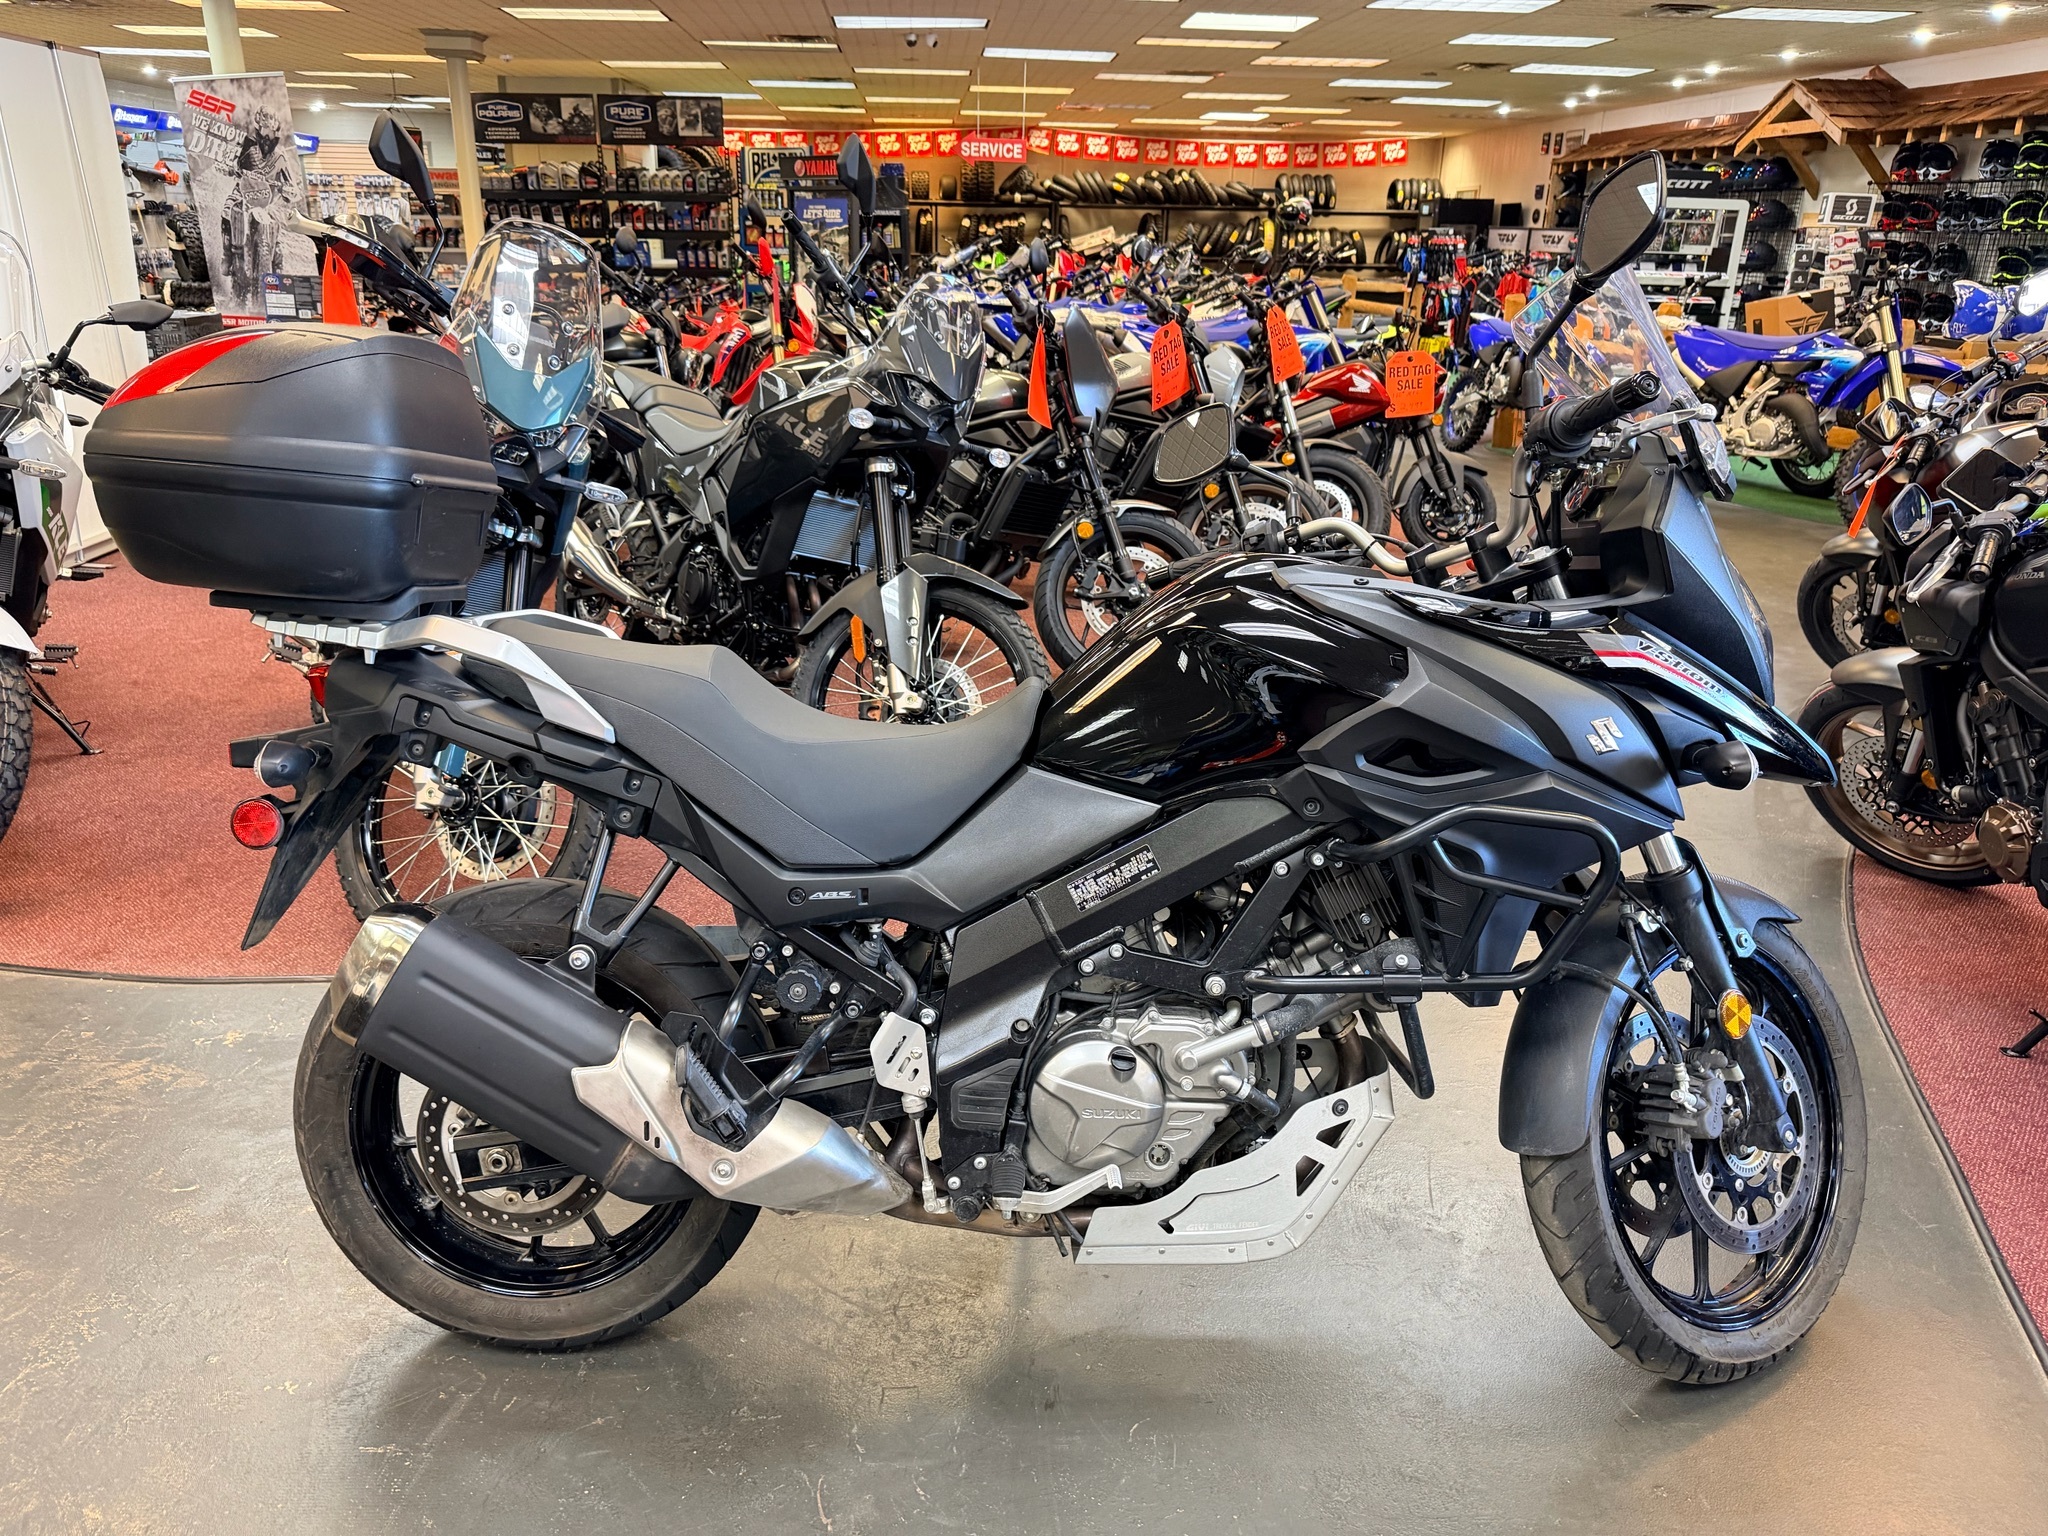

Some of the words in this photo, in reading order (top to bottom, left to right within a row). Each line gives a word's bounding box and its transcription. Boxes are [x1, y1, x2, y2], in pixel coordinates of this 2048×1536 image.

[187, 89, 236, 123] SSR
[610, 106, 645, 116] PURE
[191, 113, 211, 128] WE
[211, 118, 247, 143] KNOW
[1029, 129, 1048, 139] RIDE
[751, 133, 772, 143] RIDE
[784, 134, 804, 143] RIDE
[815, 135, 836, 143] RIDE
[877, 134, 897, 143] RIDE
[907, 133, 927, 143] RIDE
[938, 132, 957, 143] RIDE
[1057, 134, 1077, 144] RIDE
[1087, 136, 1106, 146] RIDE
[818, 142, 839, 154] RED
[879, 141, 900, 154] RED
[909, 141, 931, 153] RED
[940, 140, 958, 153] RE
[961, 141, 1023, 158] SERVICE
[1058, 141, 1079, 153] RED
[1087, 144, 1109, 156] RED
[1116, 139, 1136, 149] RIDE
[1146, 141, 1166, 151] RIDE
[1176, 143, 1196, 152] RIDE
[1206, 144, 1225, 154] RIDE
[1235, 144, 1255, 154] RIDE
[1265, 144, 1285, 155] RIDE
[1295, 145, 1315, 155] RIDE
[1325, 144, 1344, 154] RIDE
[1354, 143, 1373, 153] RIDE
[1384, 141, 1403, 152] RIDE
[1117, 147, 1138, 159] RED
[1147, 149, 1168, 161] RED
[1177, 151, 1198, 163] RED
[1207, 152, 1228, 164] RED
[1236, 152, 1257, 165] RED
[1267, 153, 1288, 165] RED
[1297, 153, 1317, 165] RED
[1326, 152, 1347, 164] RED
[1355, 151, 1376, 163] RED
[1385, 149, 1406, 162] RED
[804, 160, 838, 176] YAMAH
[1667, 178, 1712, 190] COTT
[1269, 323, 1281, 339] RED
[1277, 333, 1292, 351] SALE
[1153, 344, 1169, 365] RED
[1169, 333, 1182, 354] TAG
[1161, 353, 1180, 377] SALE
[1389, 366, 1409, 378] RED
[1412, 364, 1431, 377] TAG
[1276, 366, 1282, 377] $
[1397, 378, 1423, 391] SALE
[1156, 392, 1161, 404] $
[1390, 403, 1396, 413] $
[776, 412, 829, 449] KLE
[2014, 571, 2045, 580] ONDA
[1636, 639, 1724, 695] V-Strom
[809, 890, 853, 901] ABS
[1081, 1107, 1142, 1120] SUZUKI
